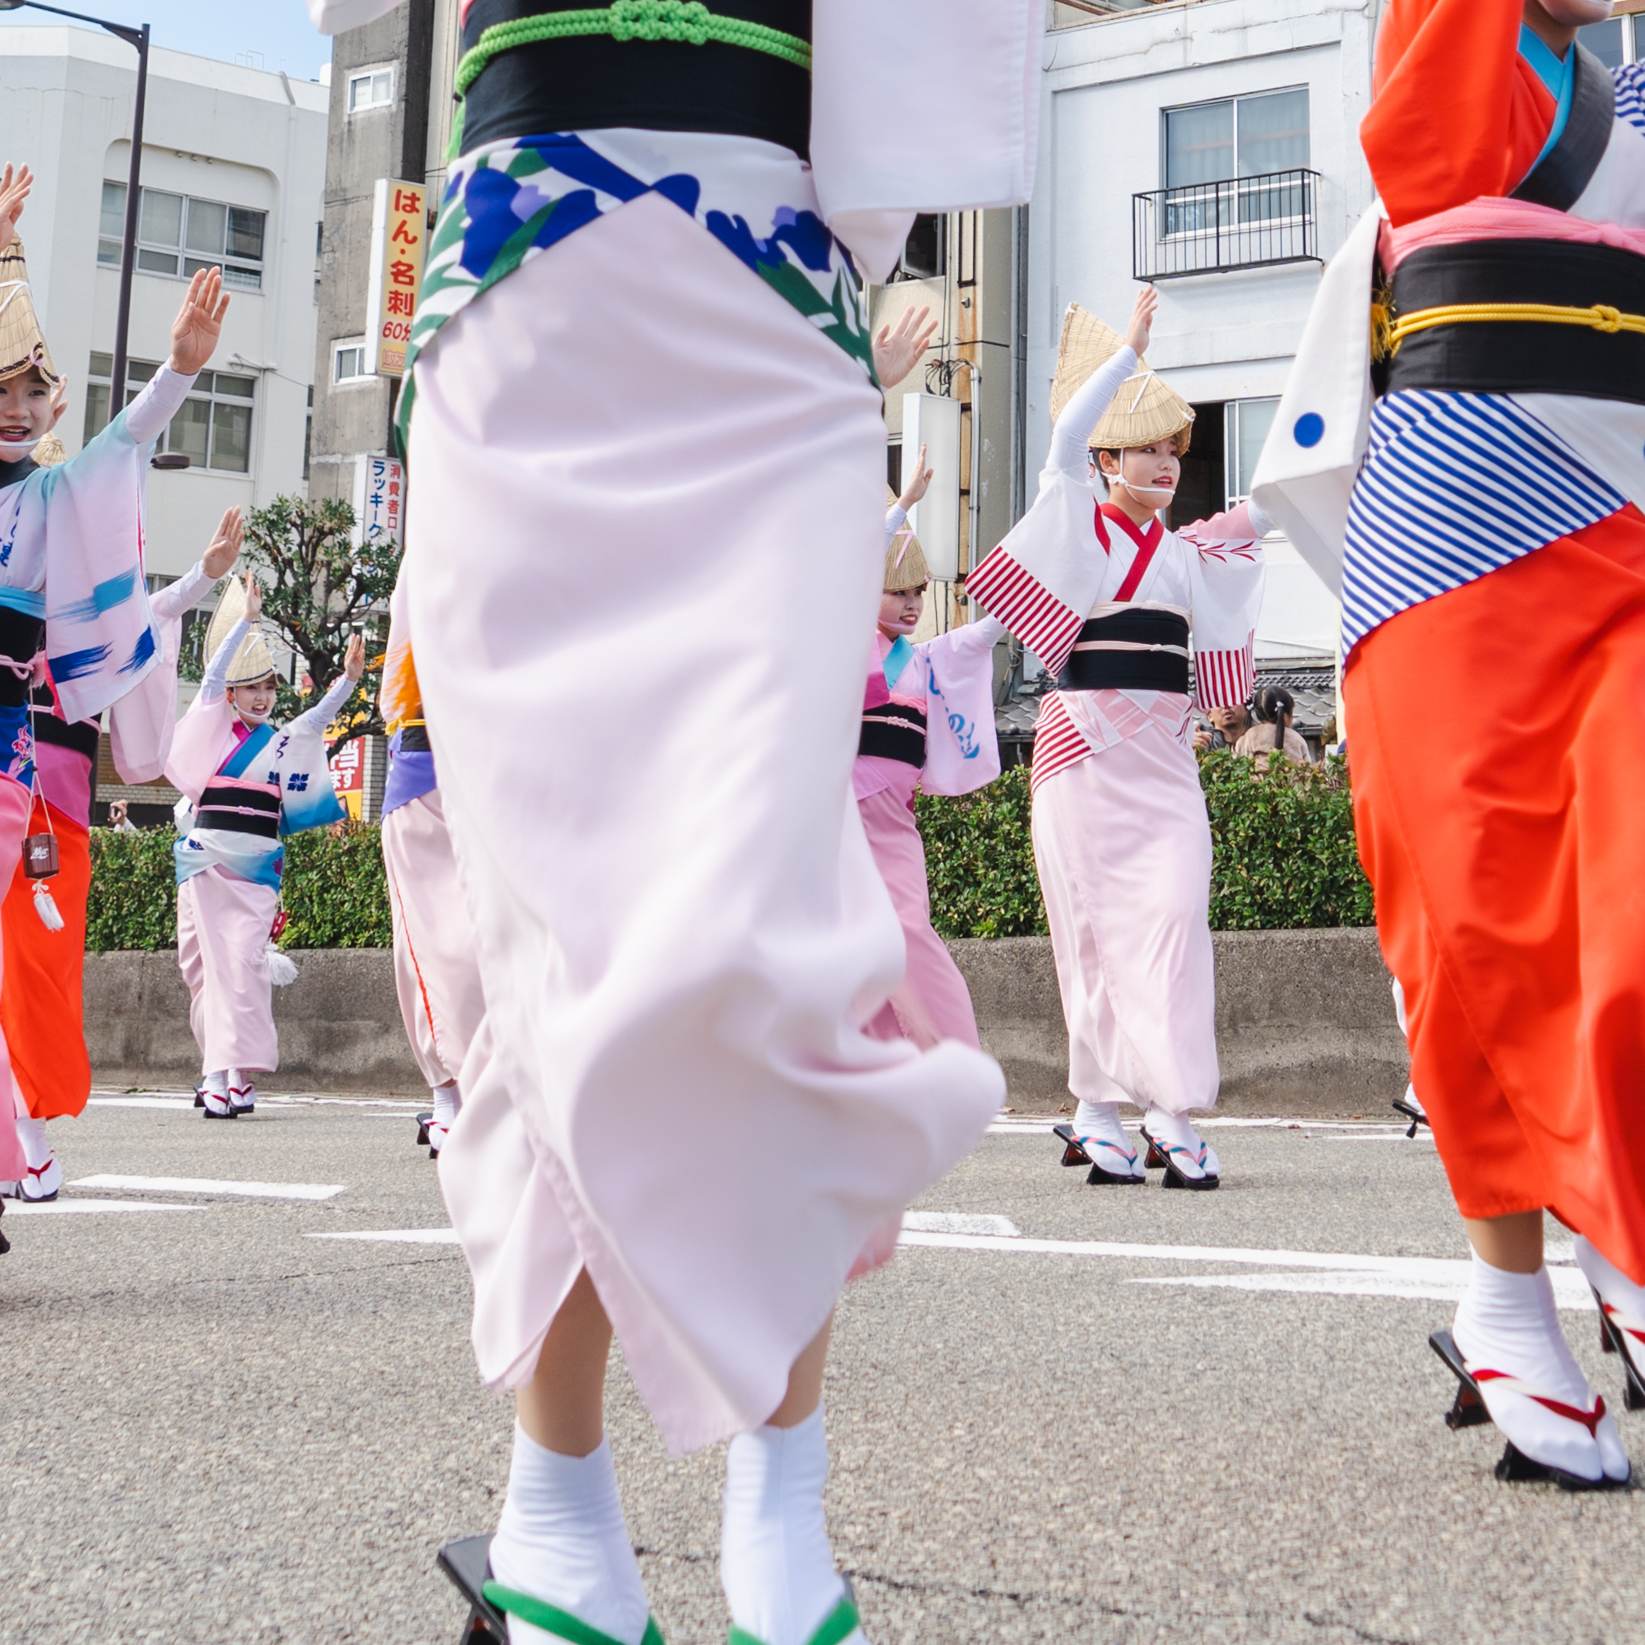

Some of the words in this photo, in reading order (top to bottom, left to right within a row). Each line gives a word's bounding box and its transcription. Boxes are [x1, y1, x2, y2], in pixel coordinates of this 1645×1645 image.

[387, 189, 421, 317] はん・名刺
